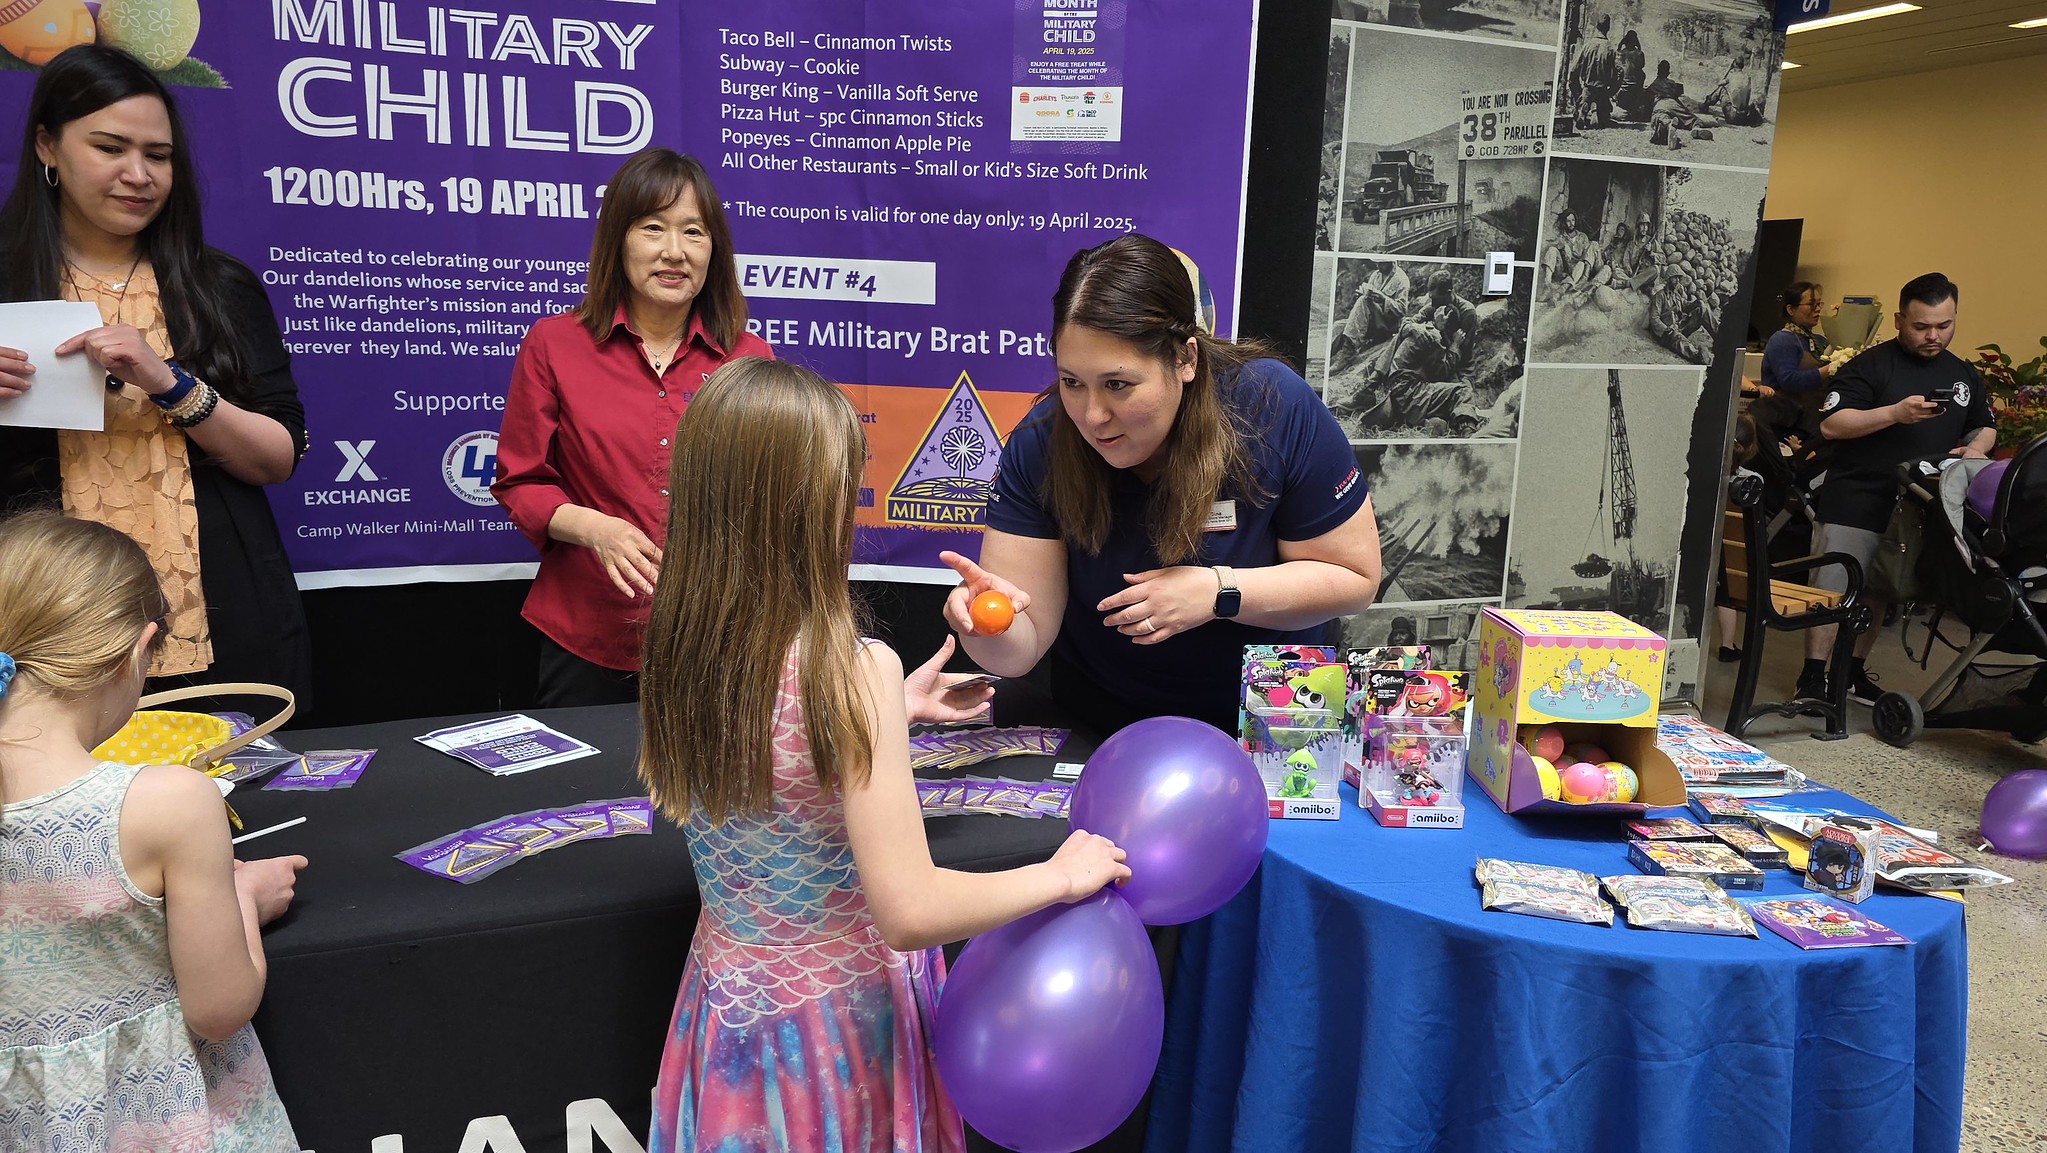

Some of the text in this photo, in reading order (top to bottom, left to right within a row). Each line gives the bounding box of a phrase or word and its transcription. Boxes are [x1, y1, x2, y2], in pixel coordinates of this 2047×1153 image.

[1044, 0, 1098, 8] MONTH
[271, 0, 654, 70] MILITARY
[1044, 20, 1096, 28] MILITARY
[718, 28, 759, 46] Taco
[764, 32, 795, 48] Bell
[814, 34, 896, 50] Cinnamon
[900, 35, 952, 51] Twists
[1043, 30, 1096, 43] CHILD
[1067, 48, 1076, 56] 19,
[720, 54, 785, 76] Subway
[804, 58, 860, 75] Cookie
[721, 79, 777, 101] Burger
[782, 82, 819, 103] King
[837, 84, 891, 101] Vanilla
[896, 85, 929, 102] Soft
[934, 86, 978, 103] Serve
[1462, 89, 1551, 111] YOU ARE NOW CROSSING
[278, 56, 654, 154] CHILD
[721, 104, 764, 122] Pizza
[769, 106, 800, 122] Hut
[818, 111, 846, 128] 5pc
[850, 109, 931, 127] Cinnamon
[936, 111, 984, 128] Sticks
[1463, 111, 1510, 142] 38 TH
[1504, 125, 1548, 140] PARALLEL
[721, 128, 791, 150] Popeyes
[810, 132, 890, 150] Cinnamon
[895, 135, 942, 154] Apple
[947, 136, 972, 152] Pie
[722, 152, 744, 168] All
[749, 154, 798, 171] Other
[802, 156, 897, 174] Restaurants
[914, 160, 958, 177] Small
[962, 165, 980, 177] or
[1026, 162, 1059, 178] Size
[1064, 162, 1097, 179] Soft
[1102, 164, 1148, 180] Drink
[264, 166, 434, 215] 1200Hrs,
[441, 176, 483, 214] 19
[491, 178, 589, 218] APRIL
[736, 201, 1137, 232] The coupon is valid for one day only: 19 April 2025.
[270, 247, 590, 274] Dedicated to celebrating our younges
[262, 270, 588, 294] Our dandelions whose service and sac
[744, 264, 877, 298] EVENT #4
[294, 293, 324, 308] the
[443, 296, 506, 313] mission
[511, 300, 541, 315] and
[545, 300, 576, 315] foc
[284, 316, 530, 339] Just like dandelions, military
[745, 318, 799, 346] REE
[808, 320, 922, 358] Military
[930, 326, 990, 354] Brat
[282, 338, 351, 354] herever
[360, 340, 400, 358] they
[404, 340, 447, 356] land.
[450, 341, 479, 356] We
[394, 390, 506, 416] Supporte
[955, 398, 973, 411] 20
[856, 412, 876, 423] rat
[955, 411, 972, 422] 25
[304, 488, 411, 506] EXCHANGE
[452, 484, 494, 502] PREVENTION
[892, 502, 980, 522] MILITARY
[297, 519, 518, 540] Camp Walker Mini-Mall Team
[1371, 674, 1404, 687] Splatoon
[1293, 804, 1332, 815] amiibo
[1416, 813, 1454, 823] amiibo
